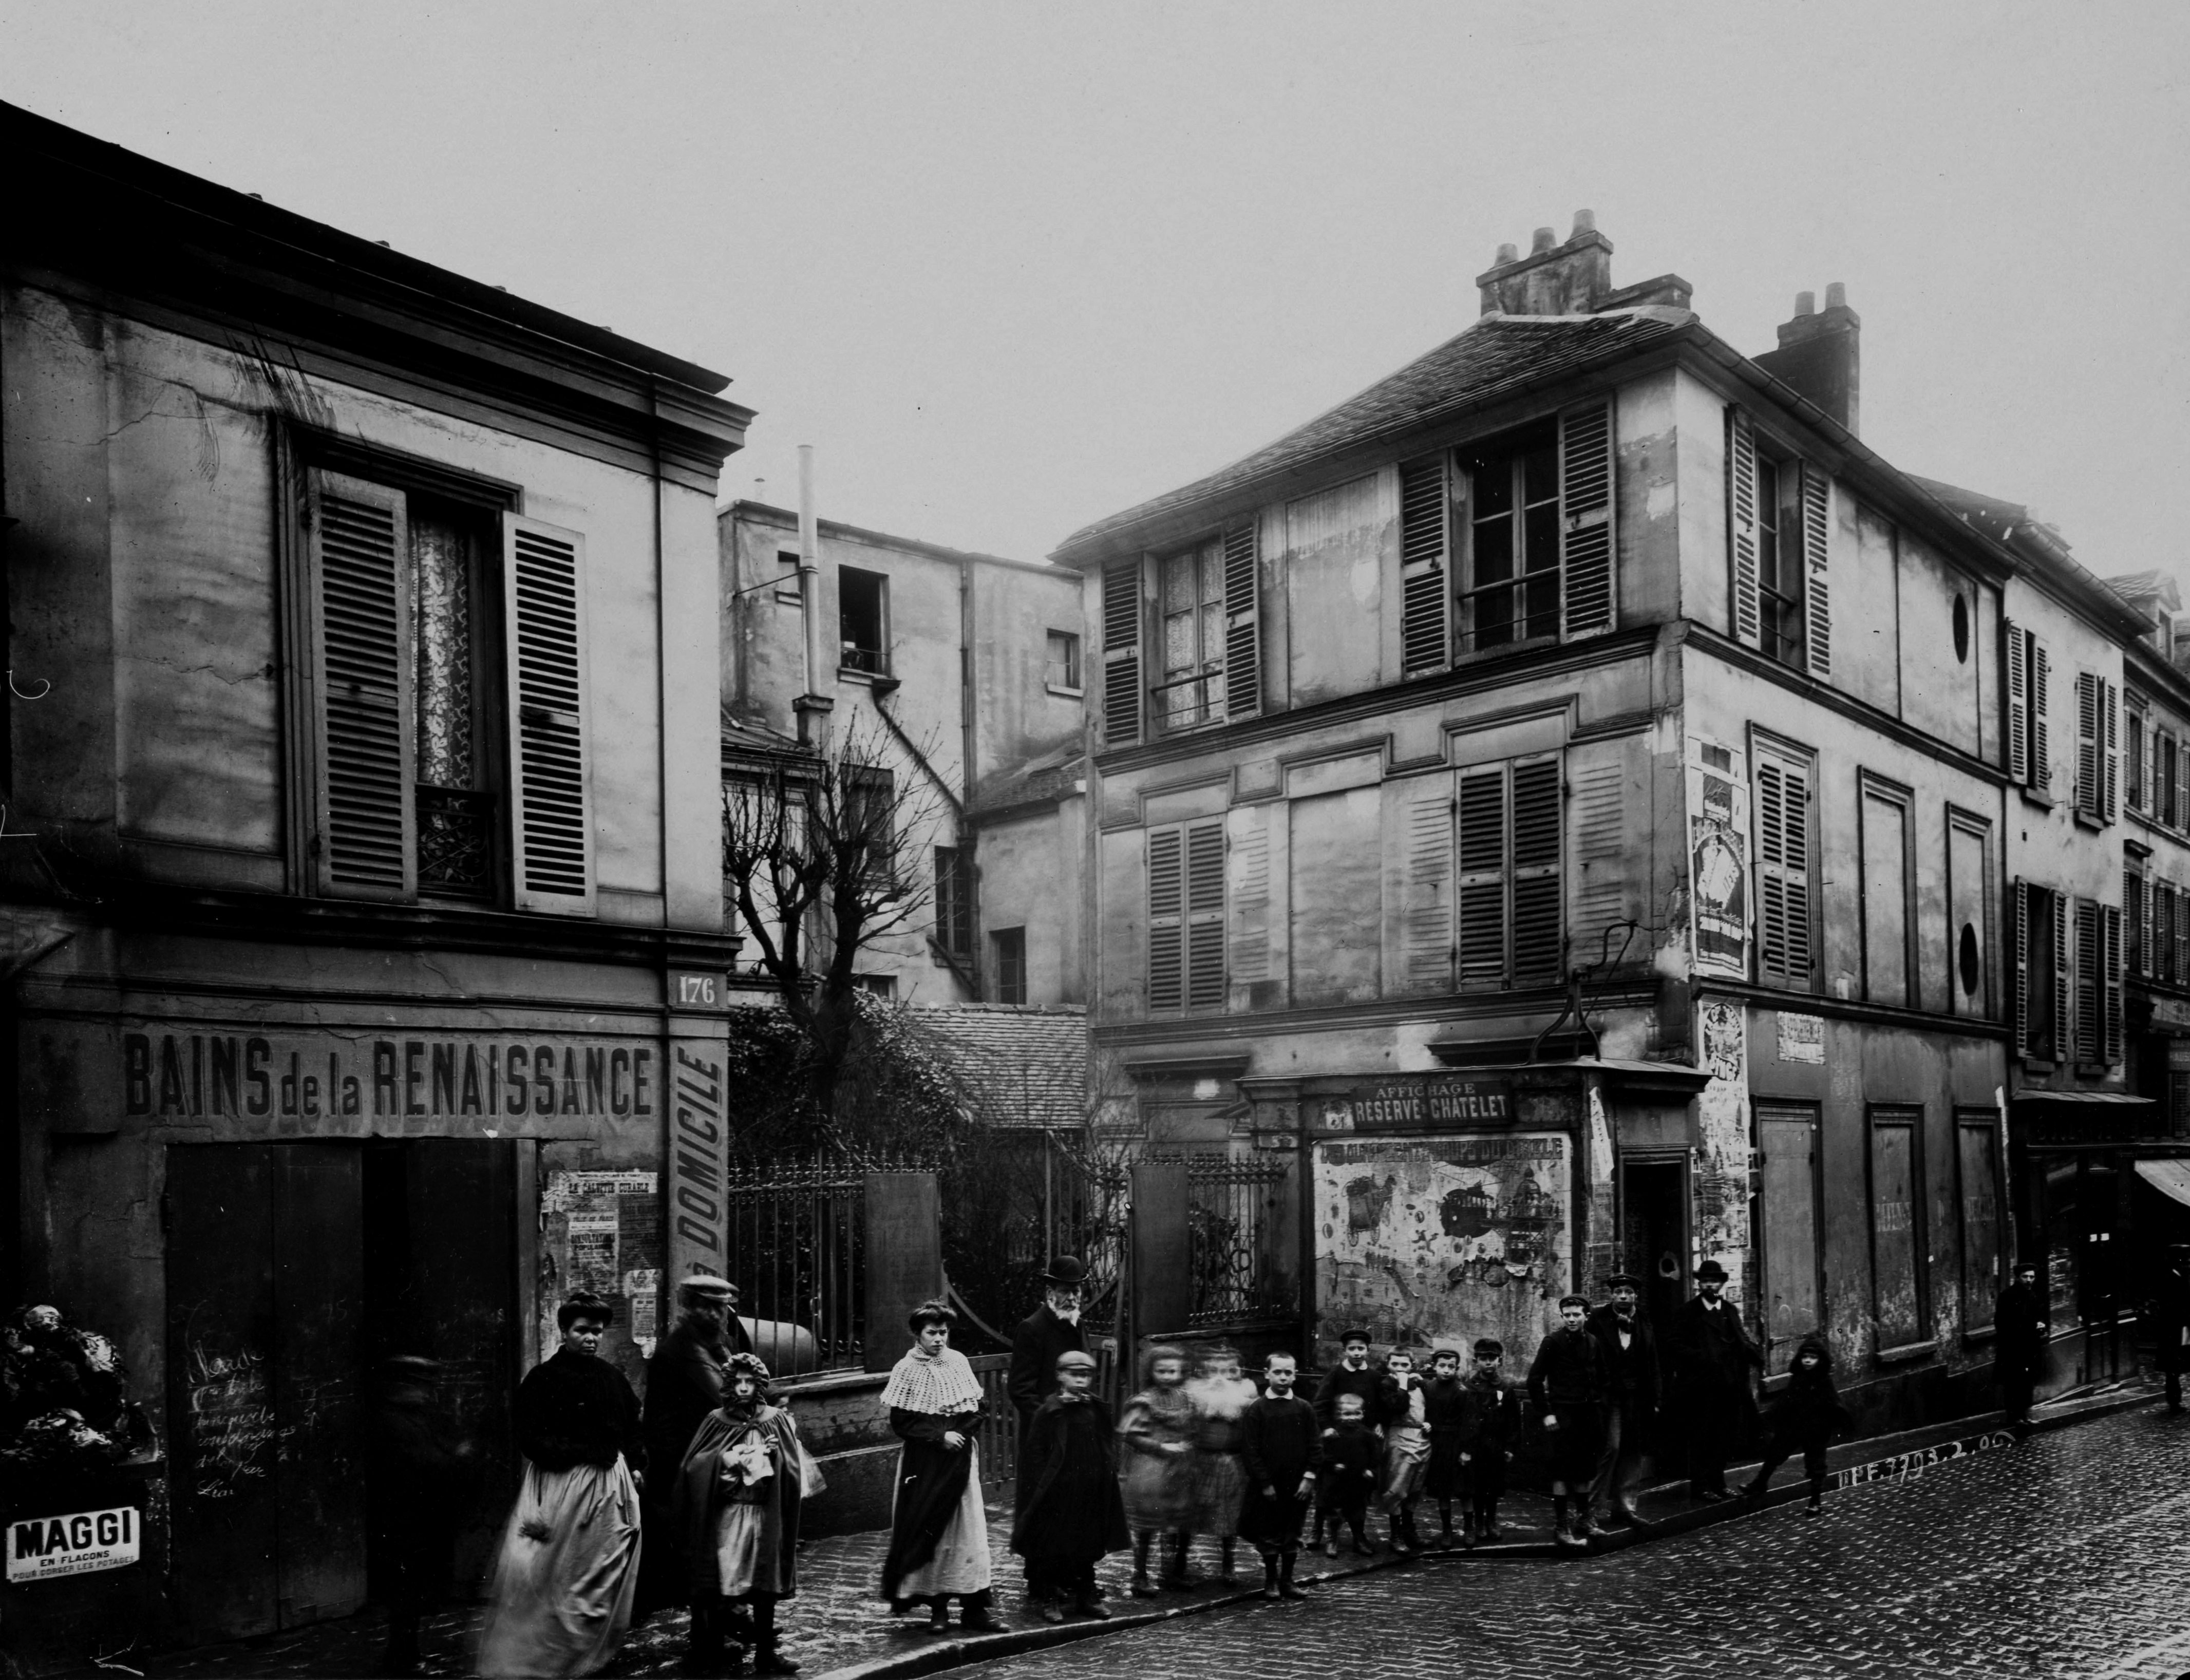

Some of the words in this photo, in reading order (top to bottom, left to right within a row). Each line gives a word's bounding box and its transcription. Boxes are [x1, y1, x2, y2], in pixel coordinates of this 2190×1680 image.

[679, 976, 715, 1003] 176
[125, 1034, 271, 1116] BAINS
[281, 1051, 319, 1116] de
[330, 1052, 361, 1116] la
[374, 1041, 651, 1116] RENAISSANCE
[1375, 1083, 1476, 1099] AFFICHAGE
[677, 1046, 719, 1252] DOMICILE
[15, 1509, 131, 1559] MAGGI
[40, 1558, 55, 1567] EN
[61, 1550, 110, 1564] FLACONS
[41, 1564, 74, 1577] CORSER
[78, 1562, 94, 1571] LES
[97, 1555, 135, 1568] POTAGES
